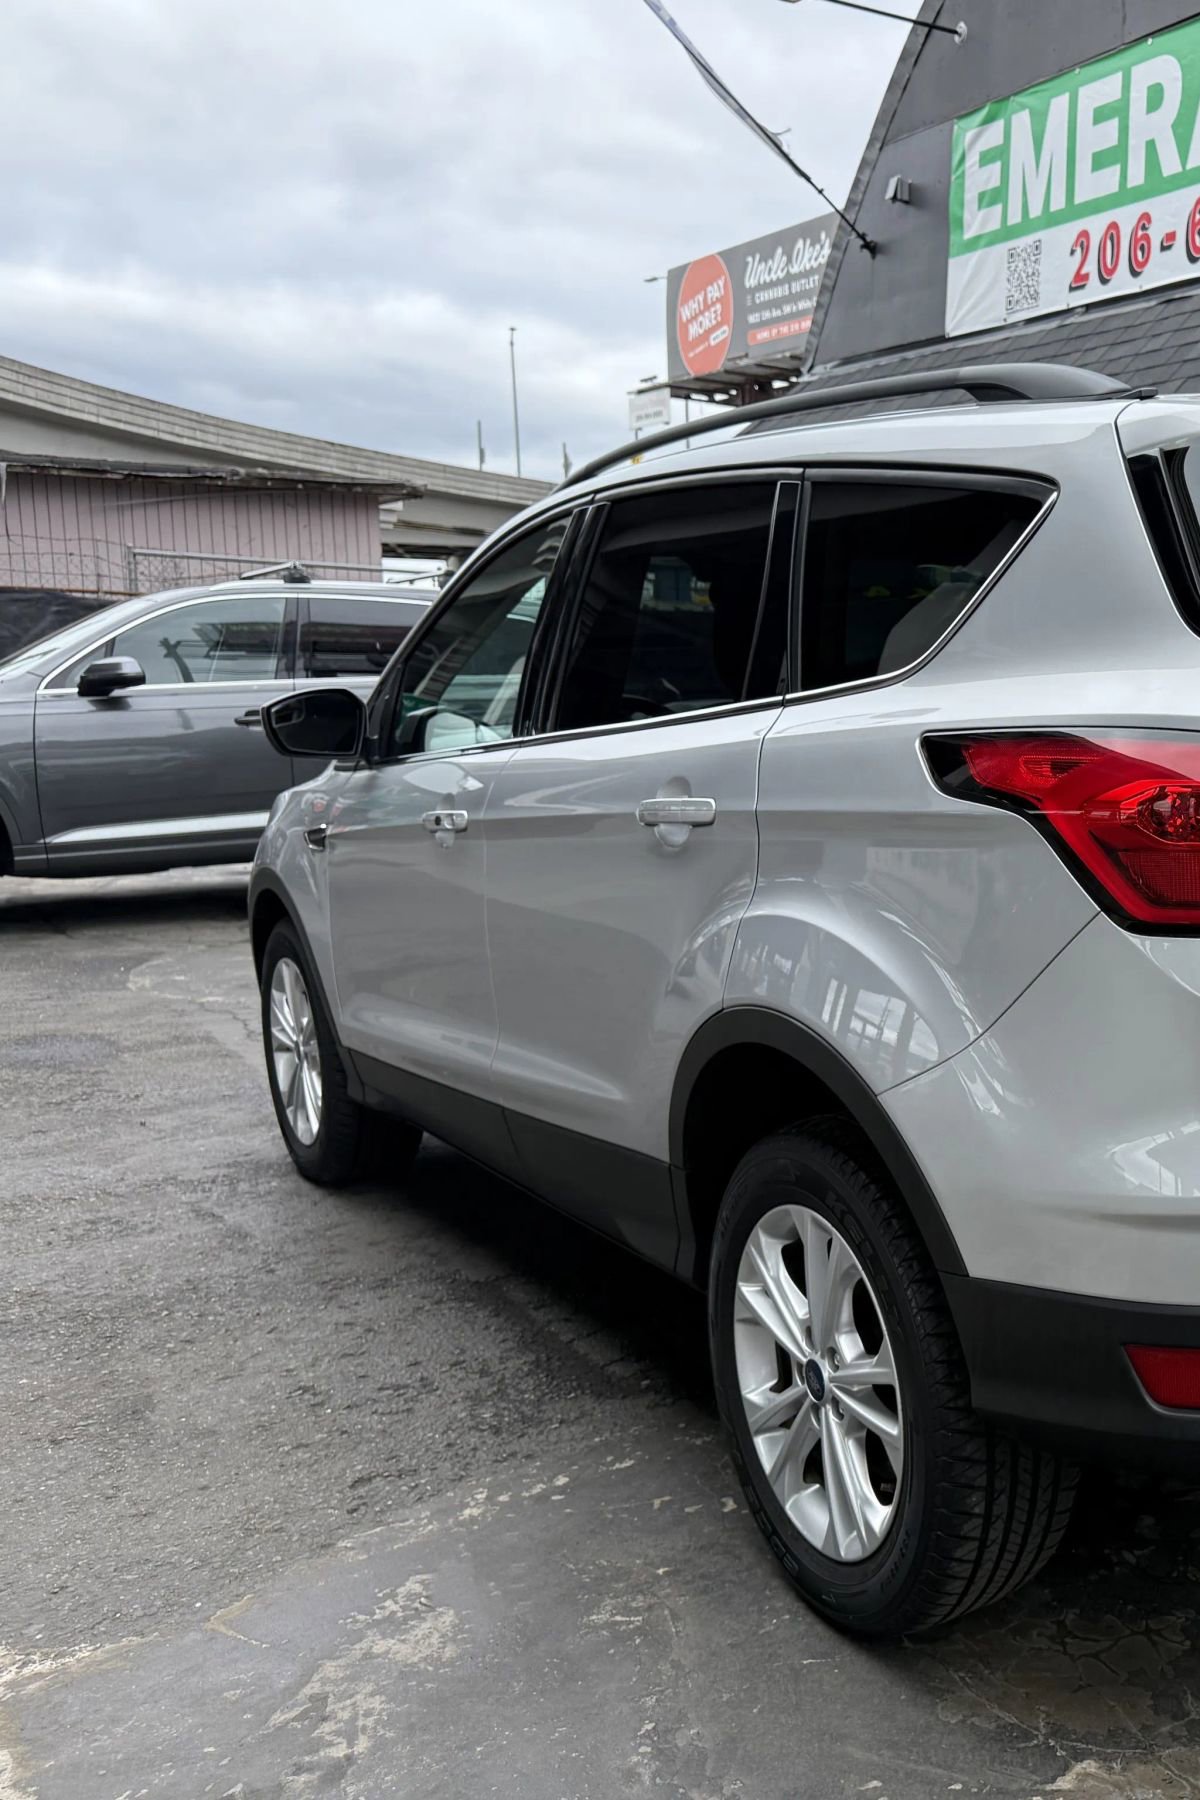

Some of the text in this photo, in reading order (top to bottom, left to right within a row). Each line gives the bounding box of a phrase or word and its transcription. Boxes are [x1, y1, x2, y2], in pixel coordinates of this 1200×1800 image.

[744, 245, 788, 288] Uncle
[680, 290, 704, 323] WHY
[706, 275, 725, 305] PAY
[688, 302, 722, 341] MORE?
